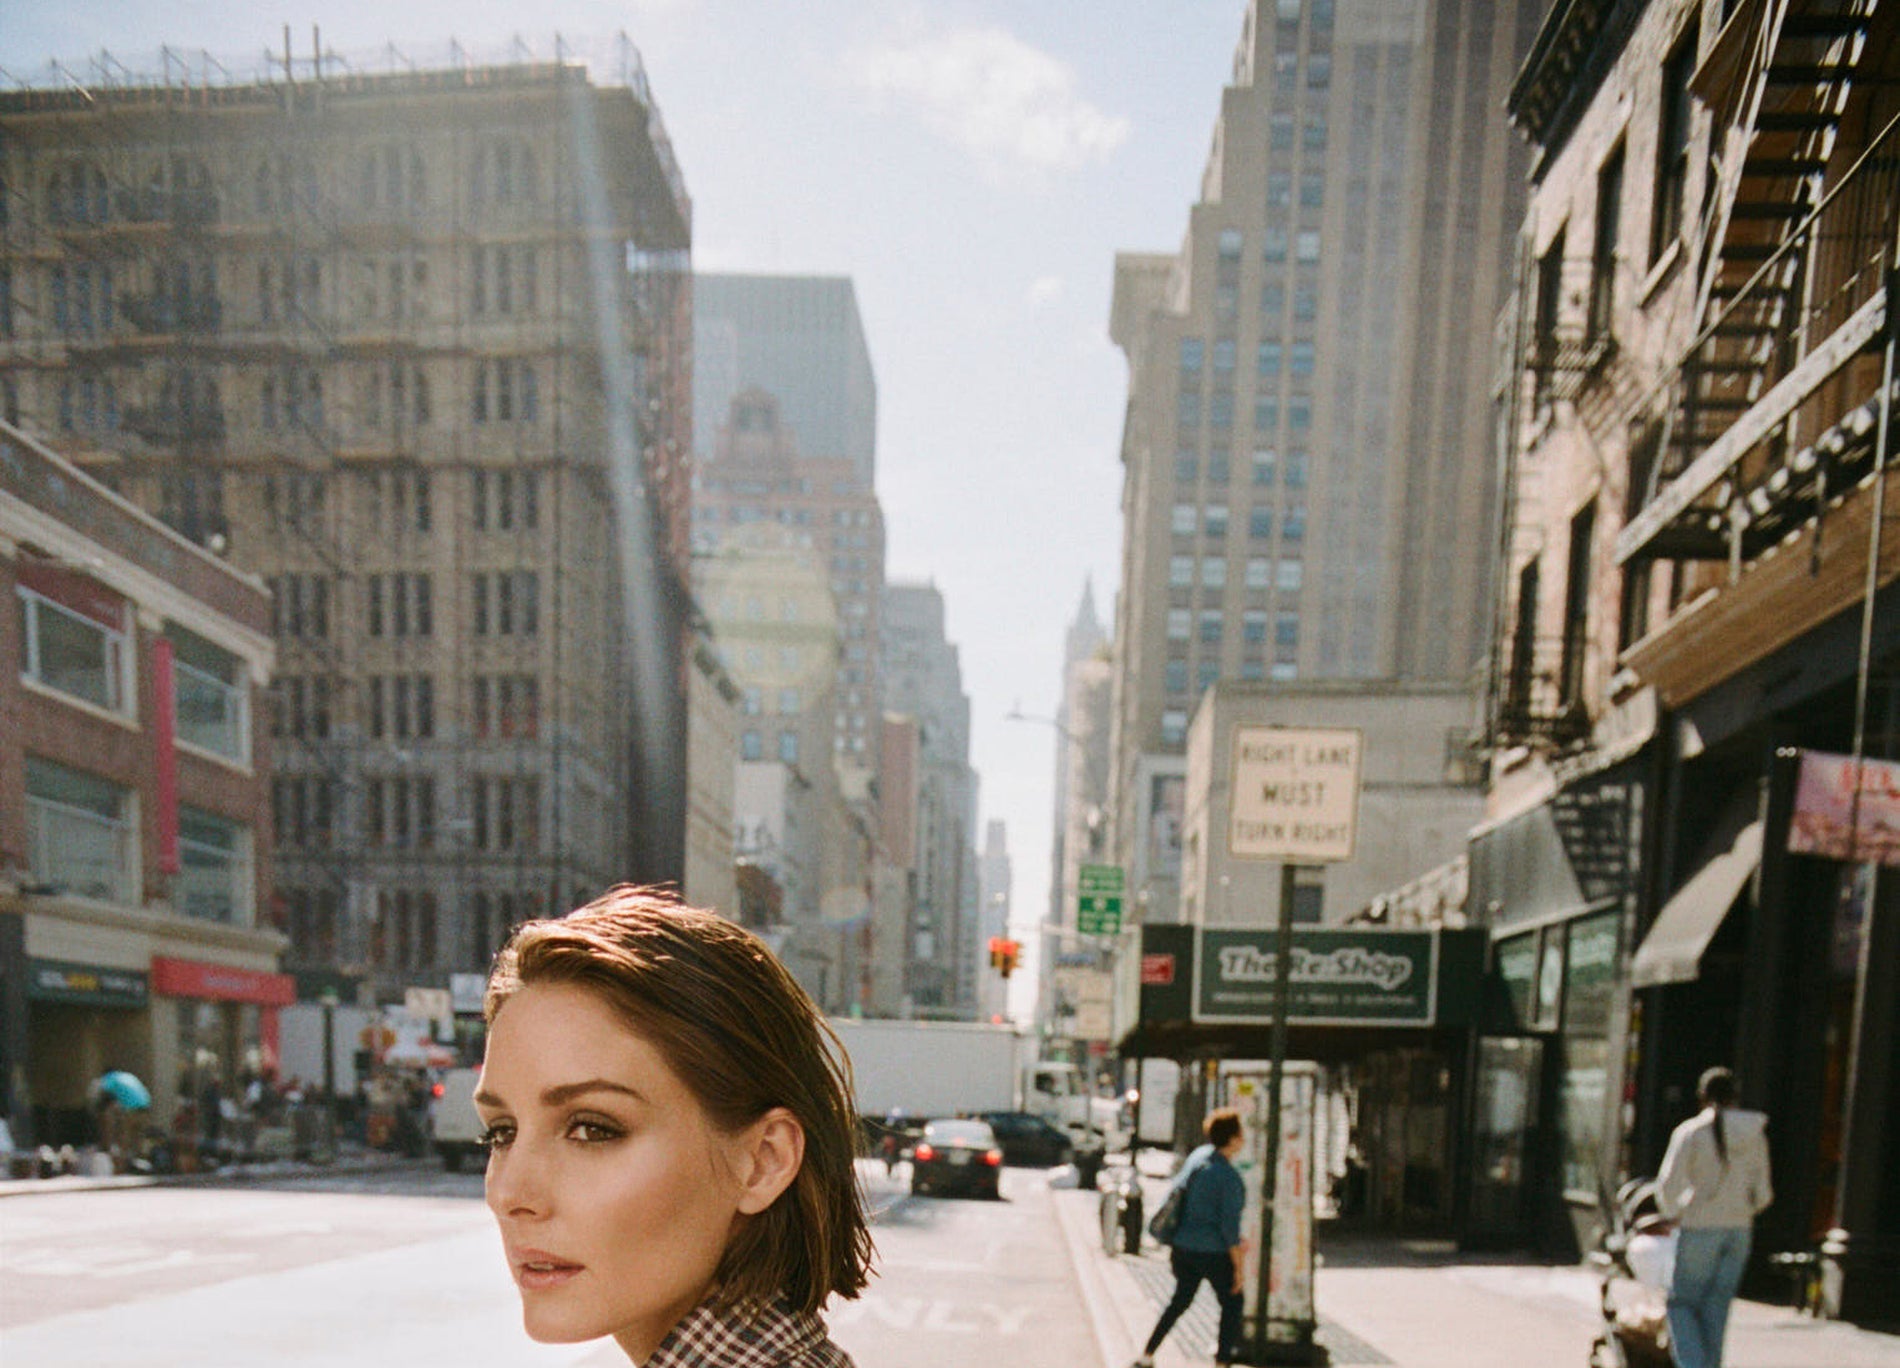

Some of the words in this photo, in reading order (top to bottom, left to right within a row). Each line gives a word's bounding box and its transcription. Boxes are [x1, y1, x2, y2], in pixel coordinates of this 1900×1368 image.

[1261, 782, 1325, 806] MUST
[1222, 948, 1277, 978] The
[838, 1298, 1035, 1335] NLY
